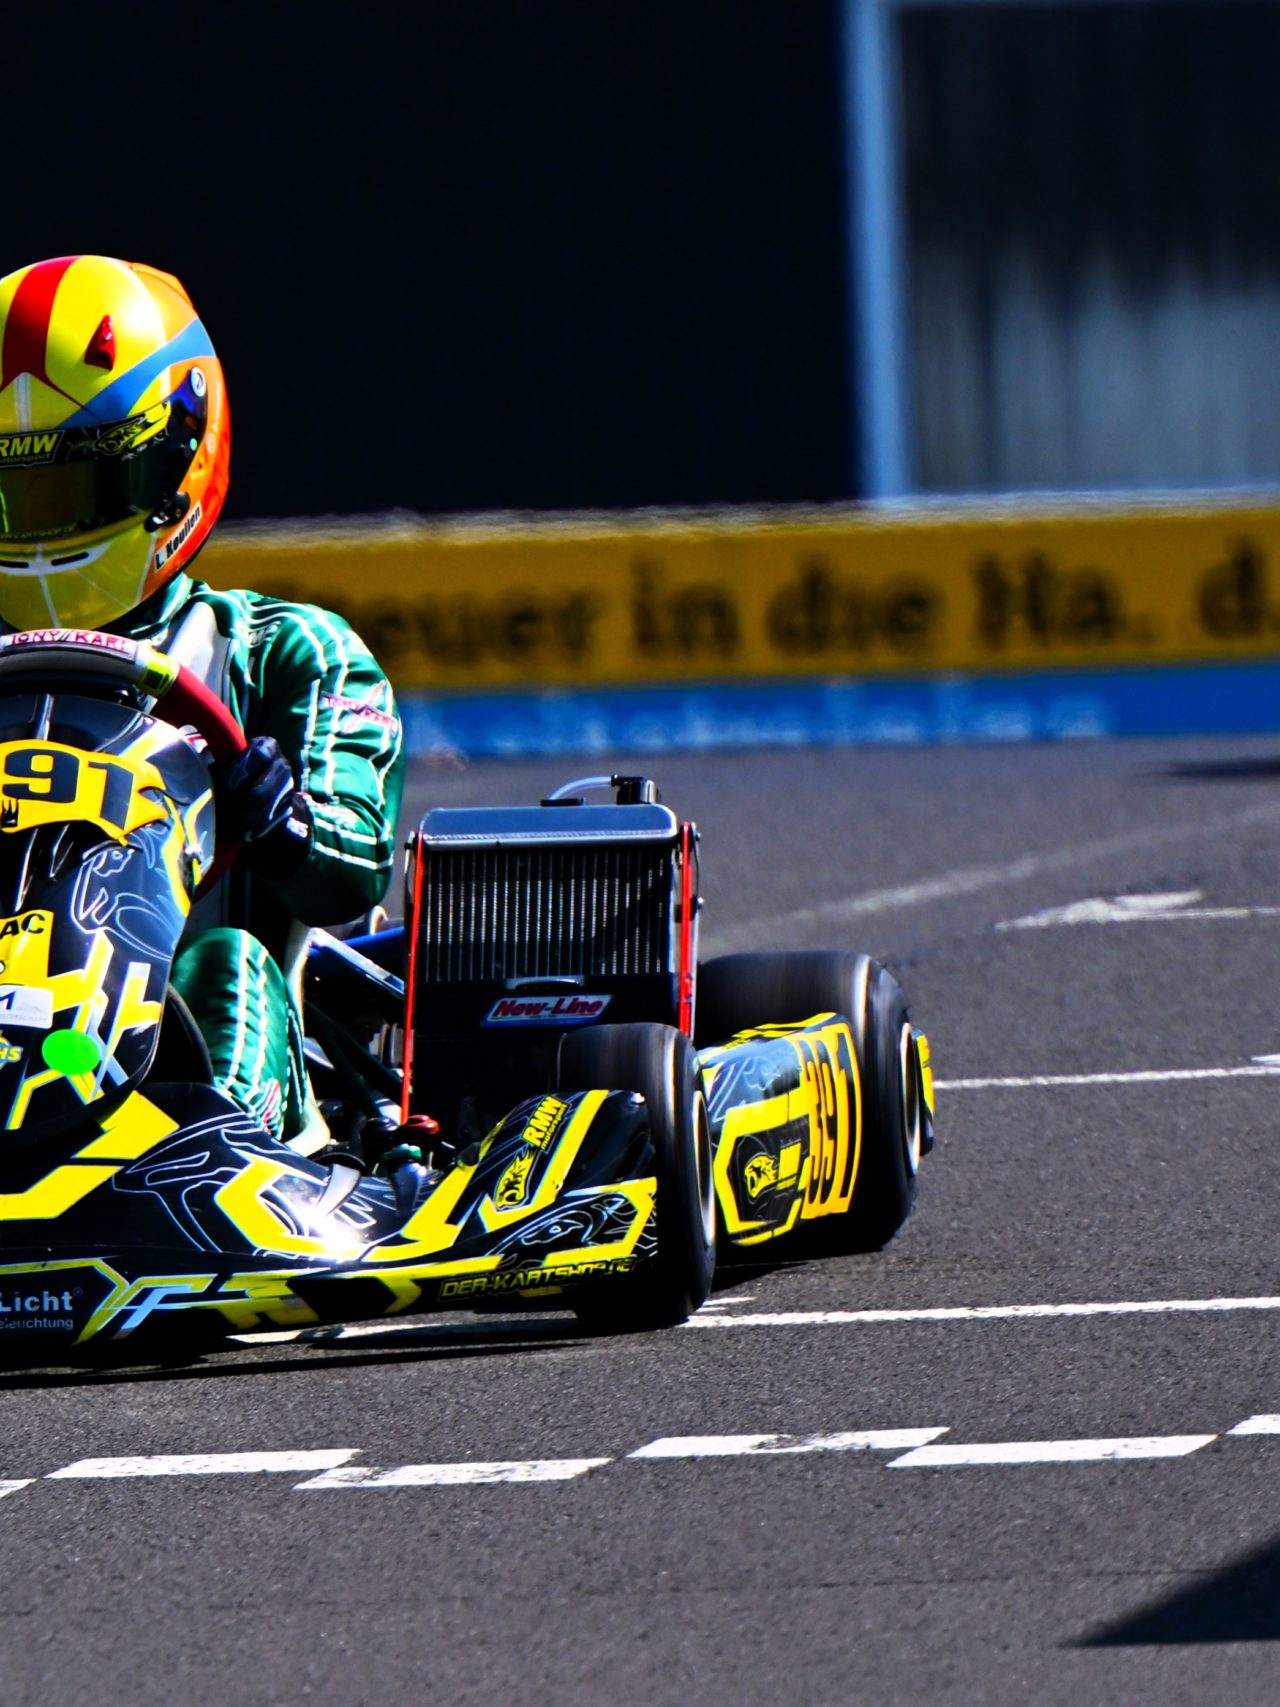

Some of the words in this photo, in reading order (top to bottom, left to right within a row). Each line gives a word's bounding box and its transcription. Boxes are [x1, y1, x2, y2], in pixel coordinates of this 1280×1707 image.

[492, 997, 604, 1017] New-Line
[522, 1095, 563, 1148] RMW
[540, 1102, 569, 1151] motorsport
